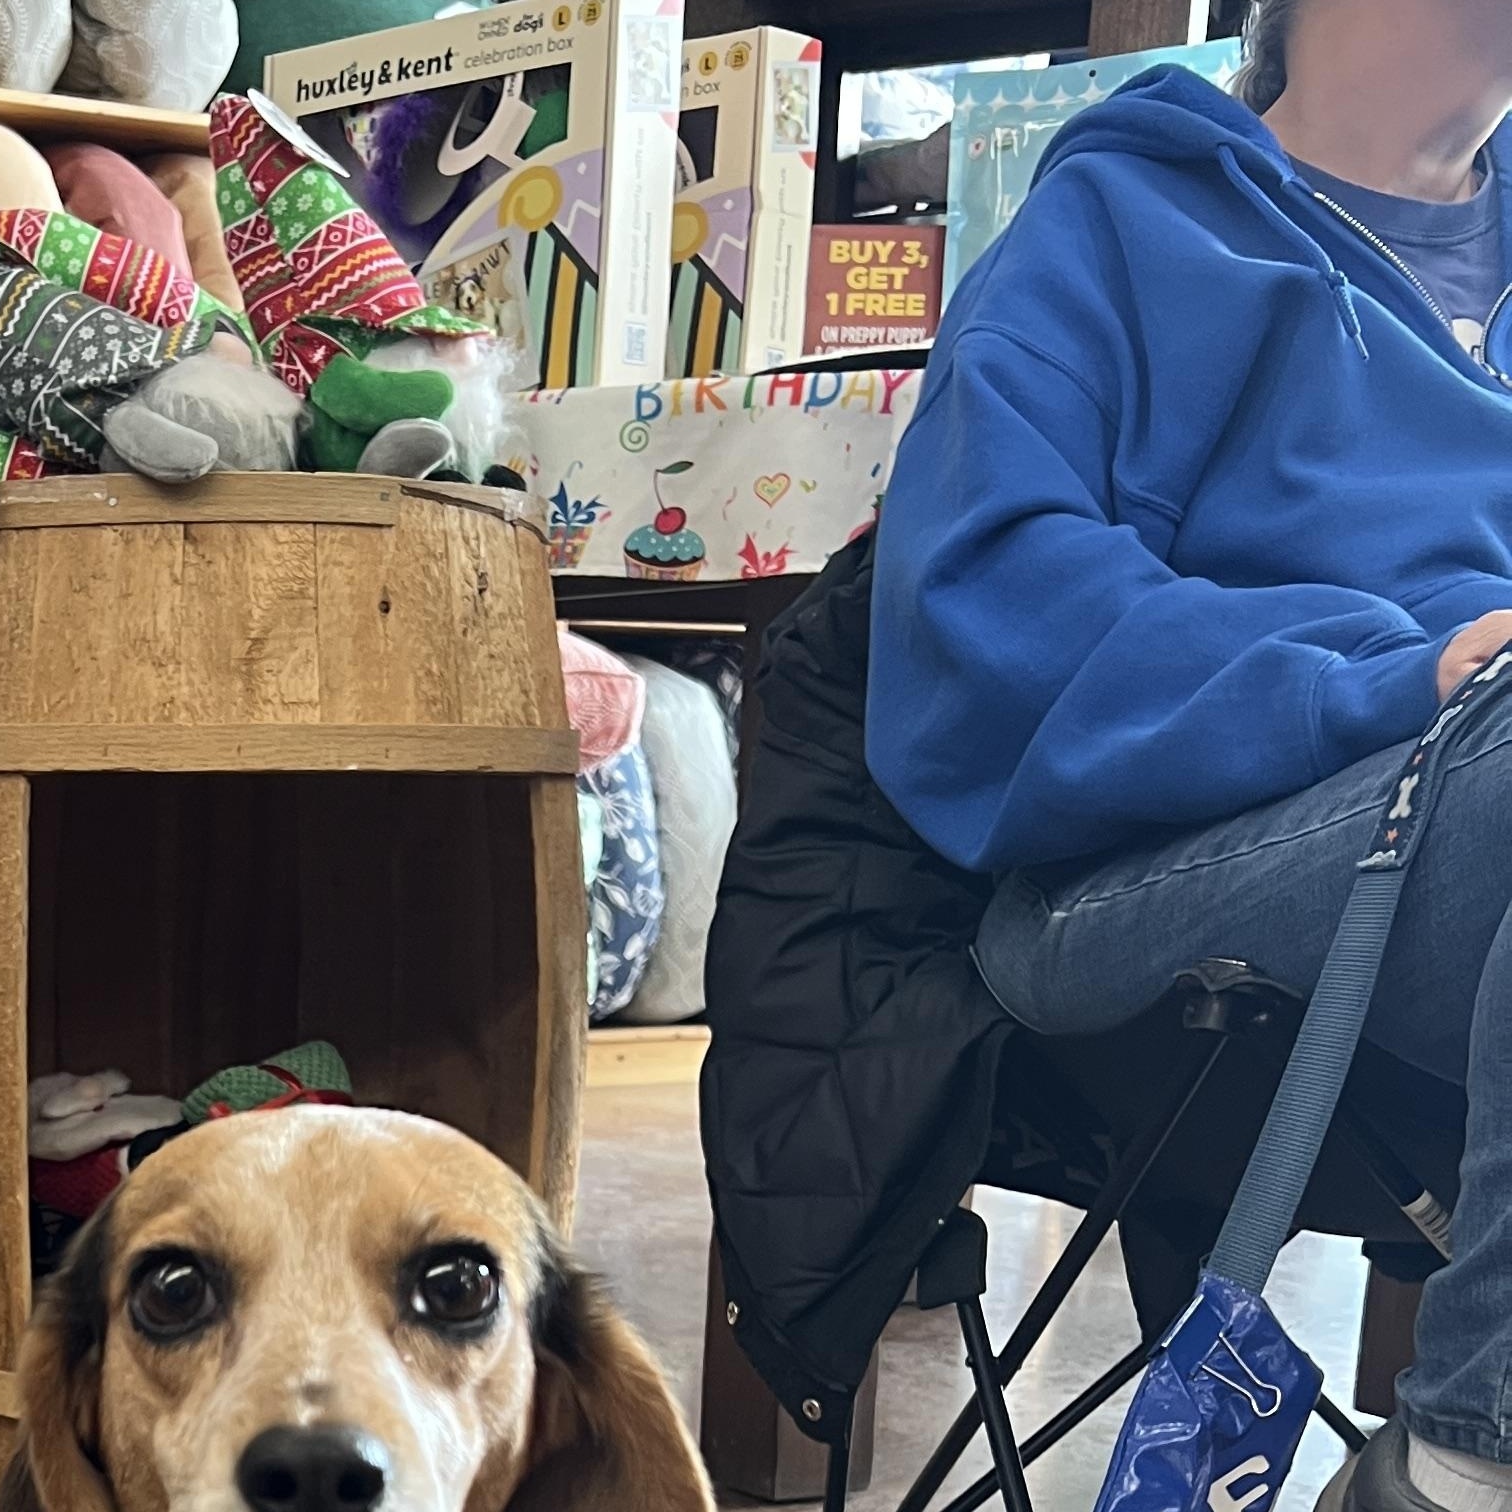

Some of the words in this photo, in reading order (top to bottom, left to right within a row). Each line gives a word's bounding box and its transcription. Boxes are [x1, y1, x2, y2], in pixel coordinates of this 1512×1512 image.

[558, 12, 565, 26] L
[464, 42, 543, 69] celebration
[547, 37, 575, 52] box
[694, 80, 721, 96] box
[829, 240, 896, 264] BUY
[901, 240, 929, 269] 3,
[846, 266, 909, 290] GET
[825, 292, 839, 316] 1
[845, 293, 926, 317] FREE
[821, 325, 839, 343] ON
[840, 325, 885, 344] PREPPY
[886, 326, 927, 344] PUPPY
